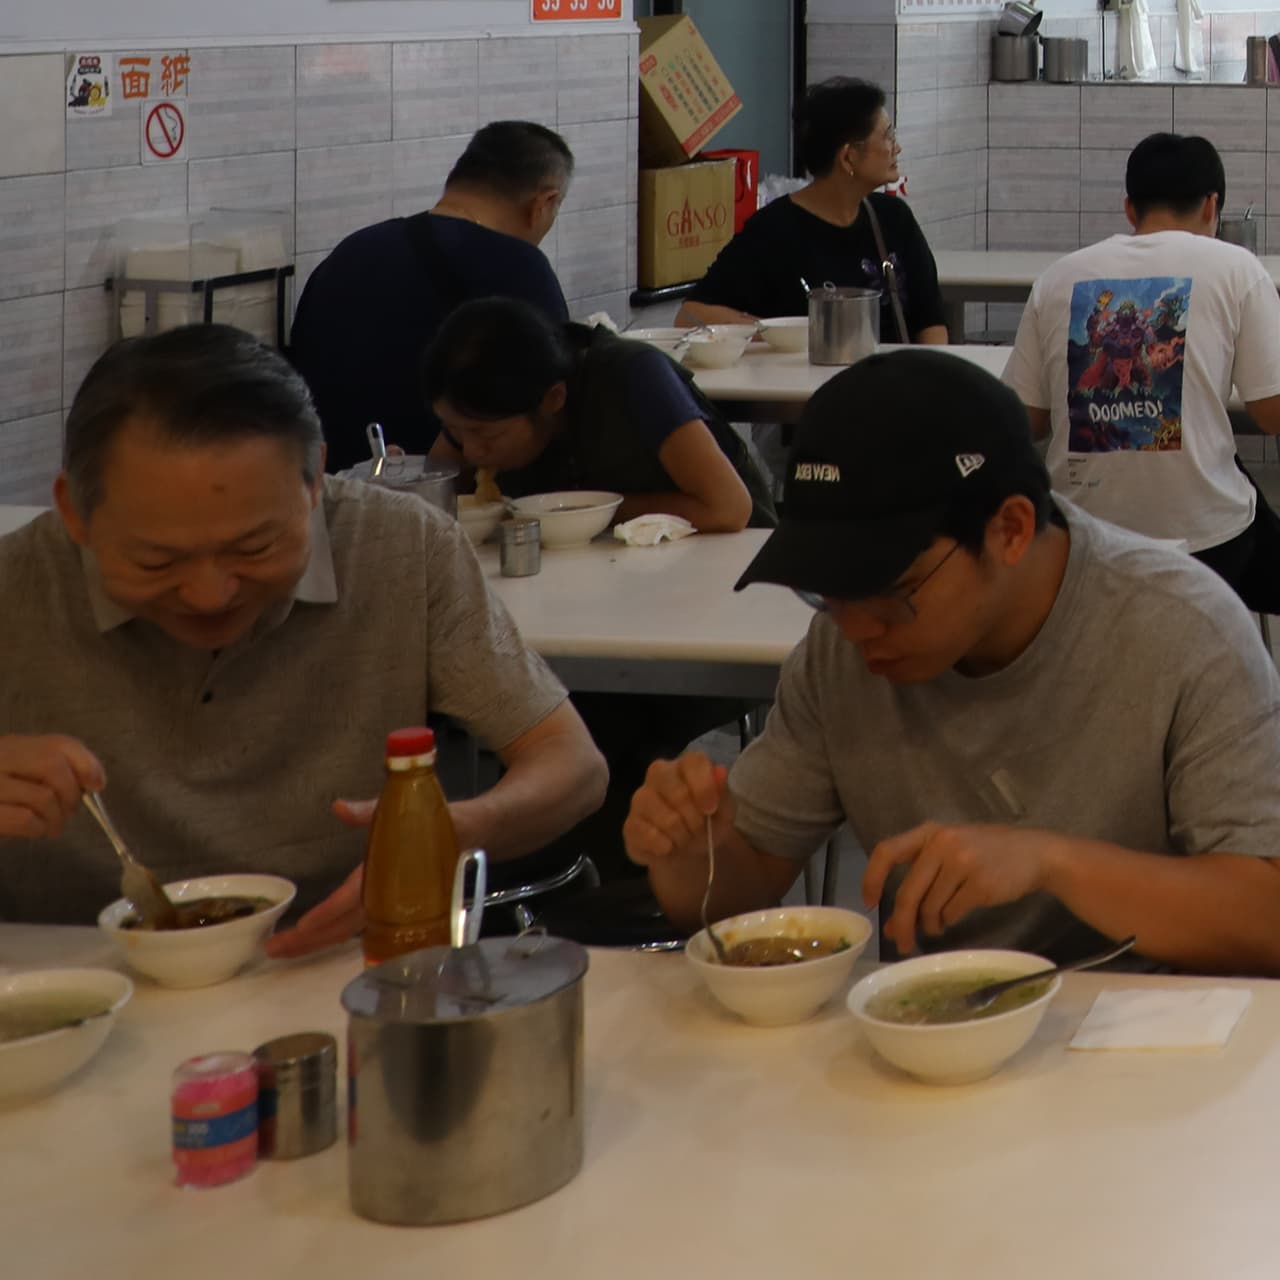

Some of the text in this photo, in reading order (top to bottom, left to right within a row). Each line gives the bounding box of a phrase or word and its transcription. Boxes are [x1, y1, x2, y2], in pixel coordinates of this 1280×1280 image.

[119, 53, 191, 100] 面紙
[666, 195, 727, 237] GANSO
[1088, 401, 1163, 423] DOOMED!
